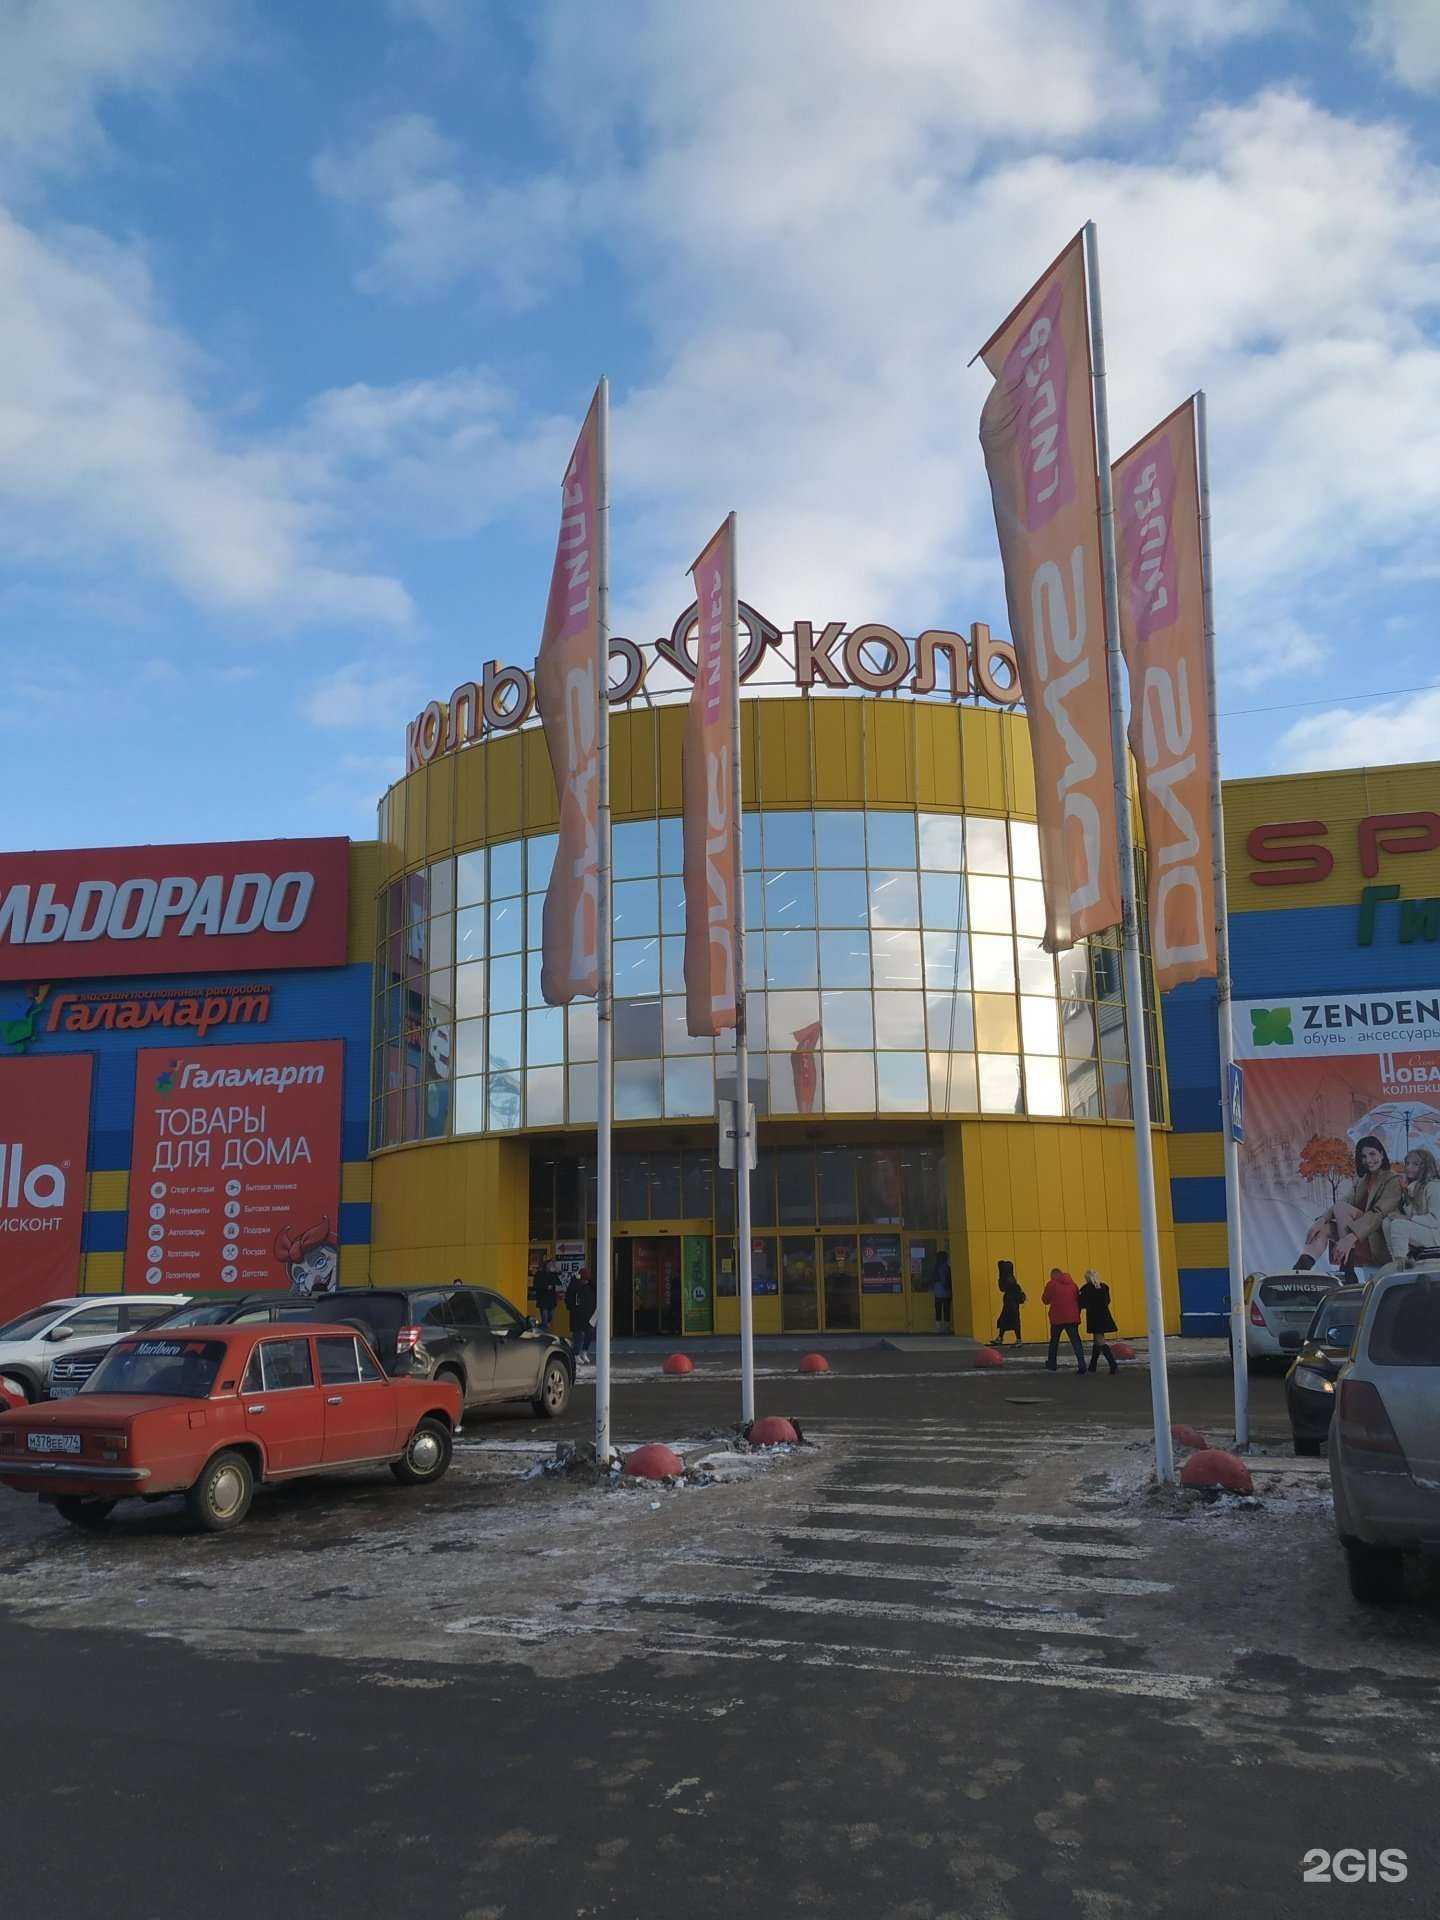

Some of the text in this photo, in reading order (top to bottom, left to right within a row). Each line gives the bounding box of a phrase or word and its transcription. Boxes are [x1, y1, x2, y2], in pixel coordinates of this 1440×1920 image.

[45, 994, 271, 1037] Галамарт
[1303, 1031, 1346, 1047] обувь
[180, 1063, 325, 1093] Галамарт
[154, 1105, 266, 1137] ТОВАРЫ
[152, 1136, 313, 1173] ДЛЯ ДОМА
[137, 1341, 181, 1355] Marlboro
